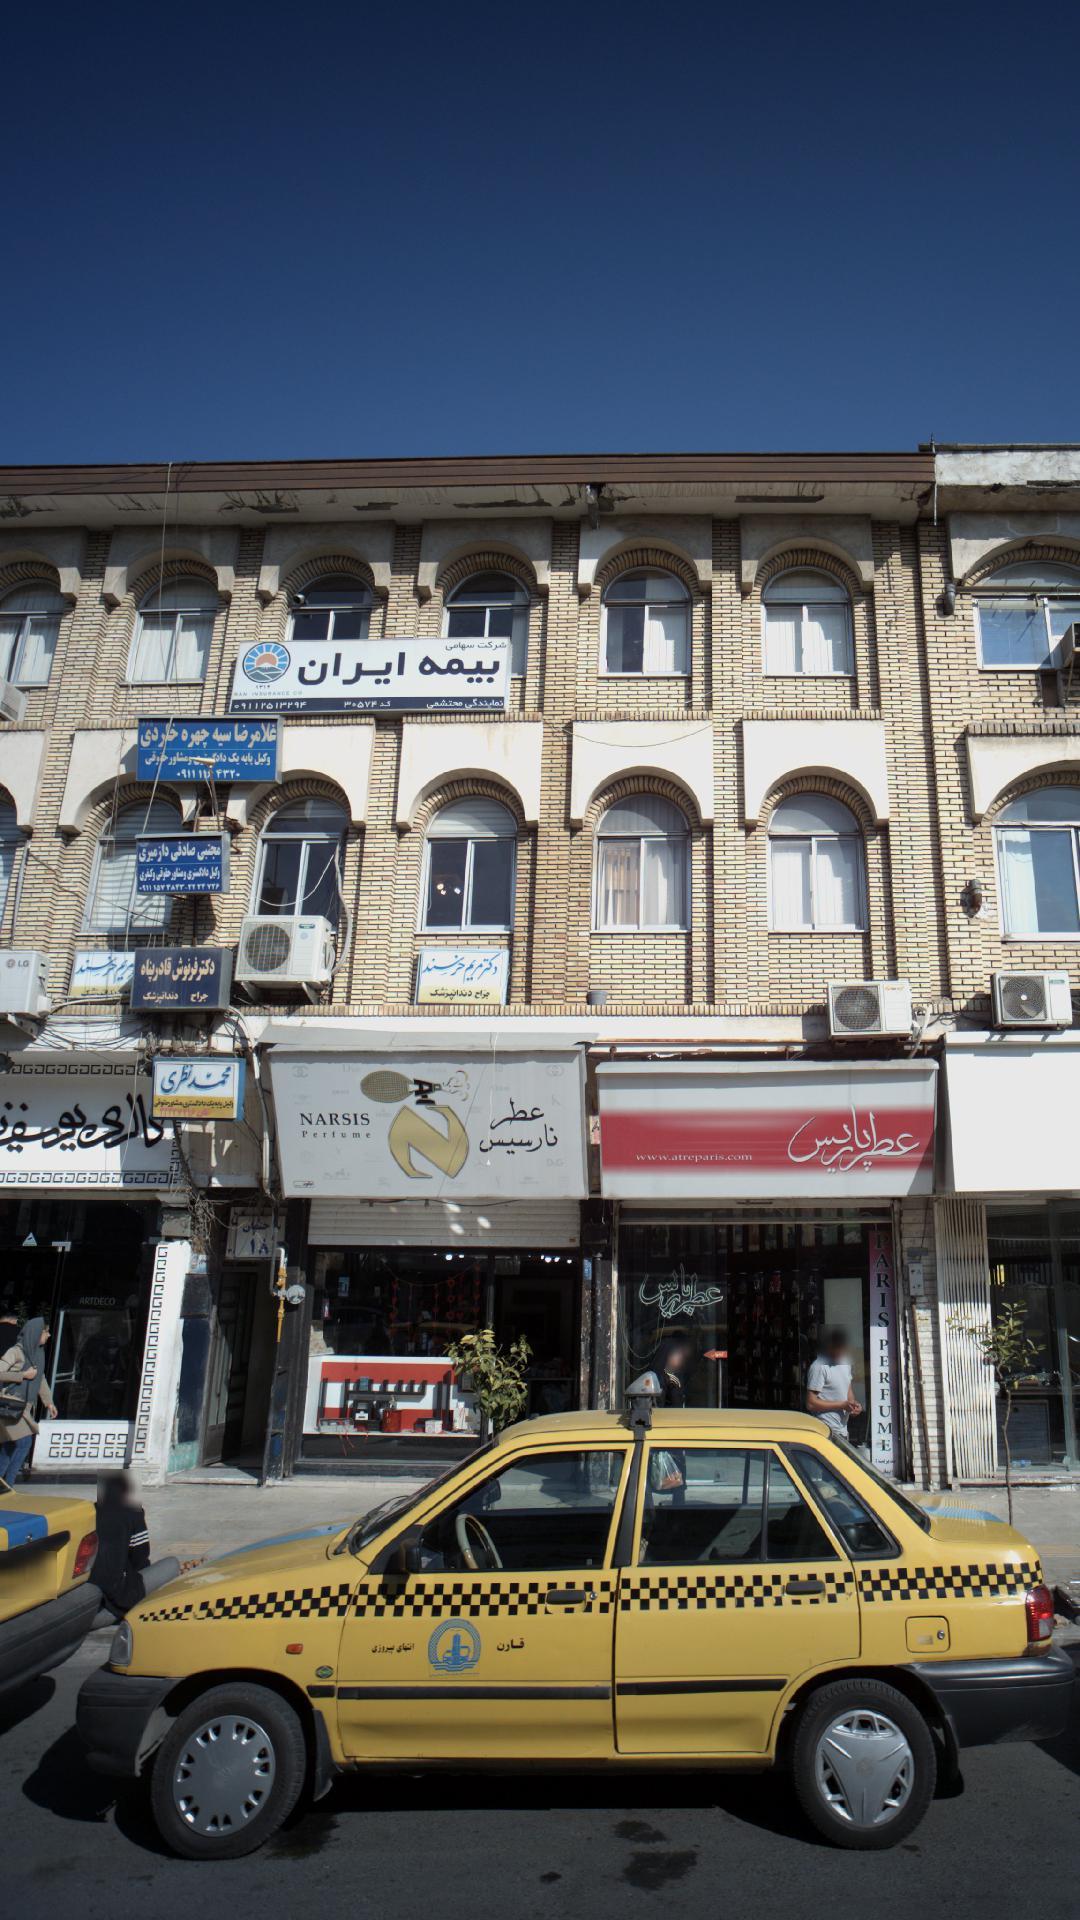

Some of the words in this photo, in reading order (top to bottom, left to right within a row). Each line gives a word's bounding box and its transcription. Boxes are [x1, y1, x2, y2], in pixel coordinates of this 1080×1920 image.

[446, 642, 475, 651] سهامی
[478, 641, 507, 650] شرکت
[298, 652, 406, 685] ایران
[418, 655, 500, 683] بیمه
[427, 699, 463, 709] محتشمی
[465, 699, 504, 709] نمایندگی
[212, 727, 231, 747] سیه
[234, 722, 277, 748] غلامرضا
[193, 752, 227, 766] دادگی
[228, 752, 240, 765] یک
[240, 752, 254, 766] پایه
[255, 752, 271, 766] وکیل
[171, 841, 196, 862] صادقی
[197, 843, 221, 861] مجتبی
[209, 866, 220, 880] وکیل
[195, 958, 215, 981] دکتر
[478, 952, 502, 980] دکتر
[142, 991, 178, 1004] دندانپزشک
[190, 991, 208, 1002] جراح
[430, 987, 472, 1001] دندانپزشک
[474, 990, 490, 1000] جراح
[161, 1064, 194, 1094] نظری
[299, 1112, 371, 1126] NARSIS
[489, 1097, 545, 1130] عطر
[302, 1130, 371, 1139] Perfume
[479, 1123, 558, 1155] نارسیس
[788, 1105, 872, 1174] پاریس
[839, 1111, 920, 1172] عطر
[635, 1152, 753, 1164] www.atreparis.com
[875, 1230, 891, 1328] PARIS
[876, 1338, 893, 1453] PERFUME
[395, 1642, 415, 1653] انتهای
[496, 1637, 525, 1651] قارن
